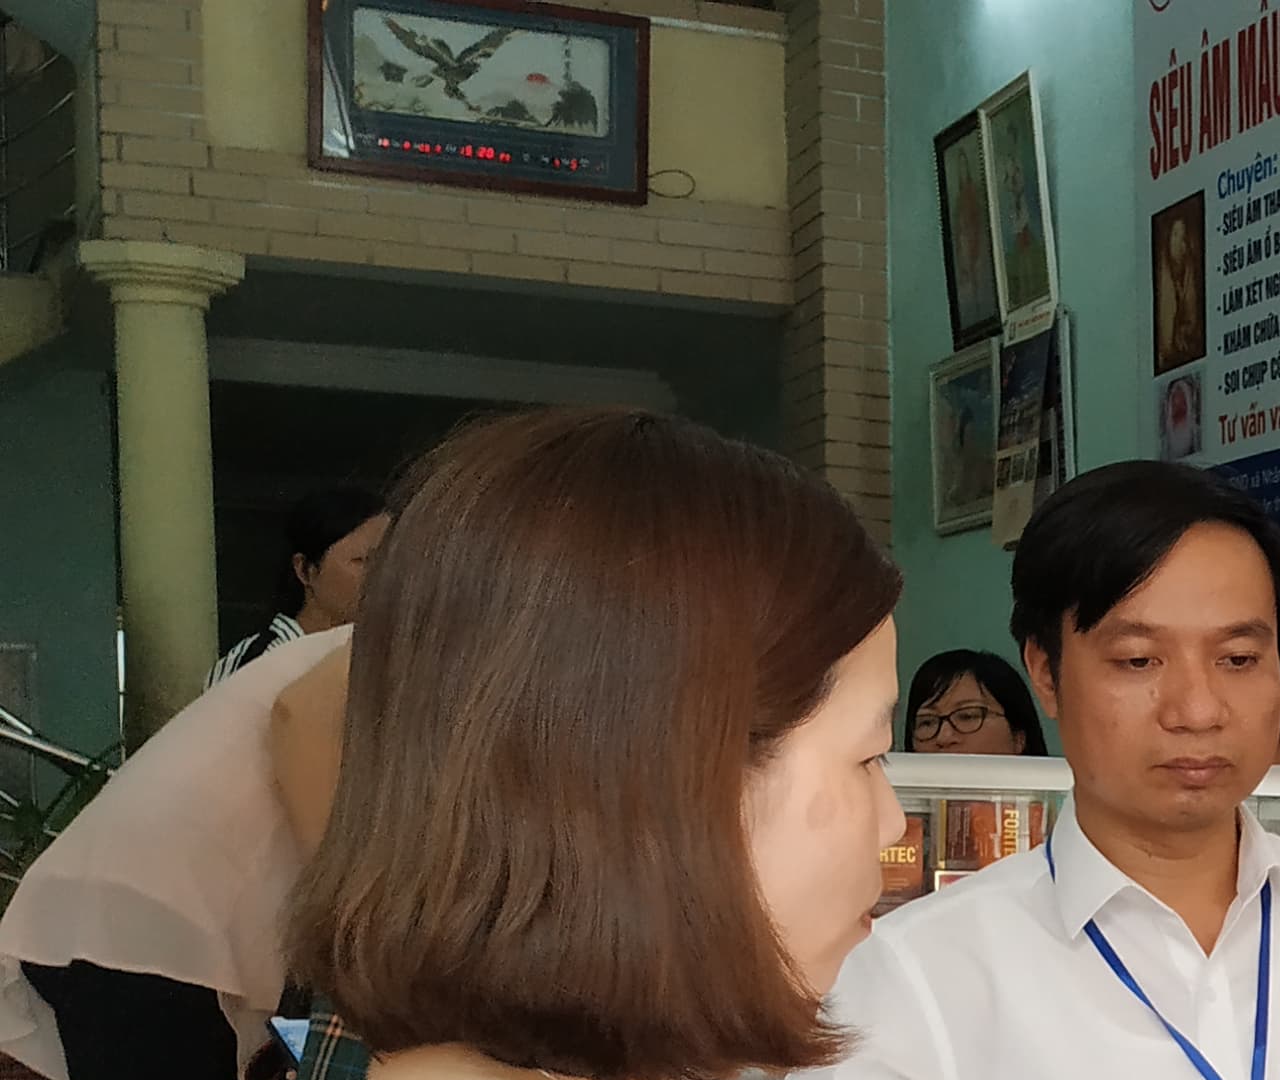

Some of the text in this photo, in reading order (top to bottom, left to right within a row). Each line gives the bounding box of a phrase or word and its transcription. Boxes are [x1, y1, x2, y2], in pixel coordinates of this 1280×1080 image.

[1150, 48, 1192, 180] SIÊU
[1199, 29, 1231, 155] ÂM
[1217, 152, 1279, 199] Chuyên:
[1223, 204, 1244, 236] SIÊU
[1223, 243, 1245, 275] SIÊU
[1224, 370, 1240, 396] SOI
[1219, 414, 1237, 446] Tư
[1240, 402, 1266, 438] vấn
[1003, 808, 1020, 856] FORTE
[879, 846, 917, 864] RTEC
